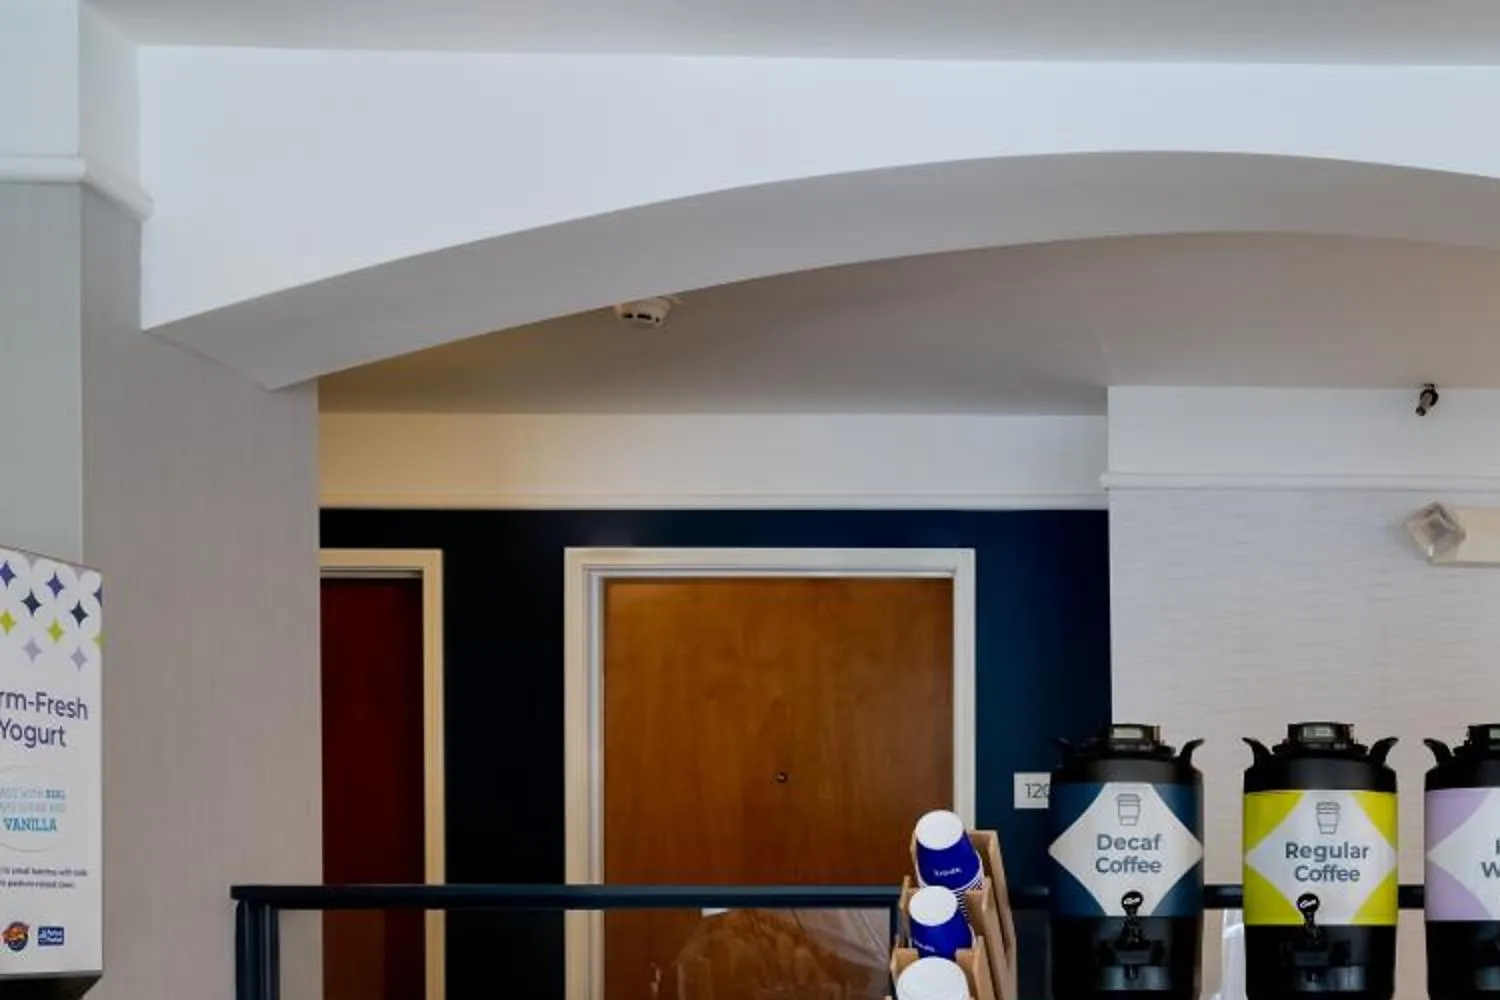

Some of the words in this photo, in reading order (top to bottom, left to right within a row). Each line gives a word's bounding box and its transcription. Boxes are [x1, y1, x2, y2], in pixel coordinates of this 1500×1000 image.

[0, 718, 67, 749] Yogurt
[3, 817, 57, 832] VANILLA
[1096, 833, 1163, 851] Decaf
[1285, 841, 1370, 862] Regular
[1095, 855, 1162, 874] Coffee
[1294, 864, 1361, 882] Coffee
